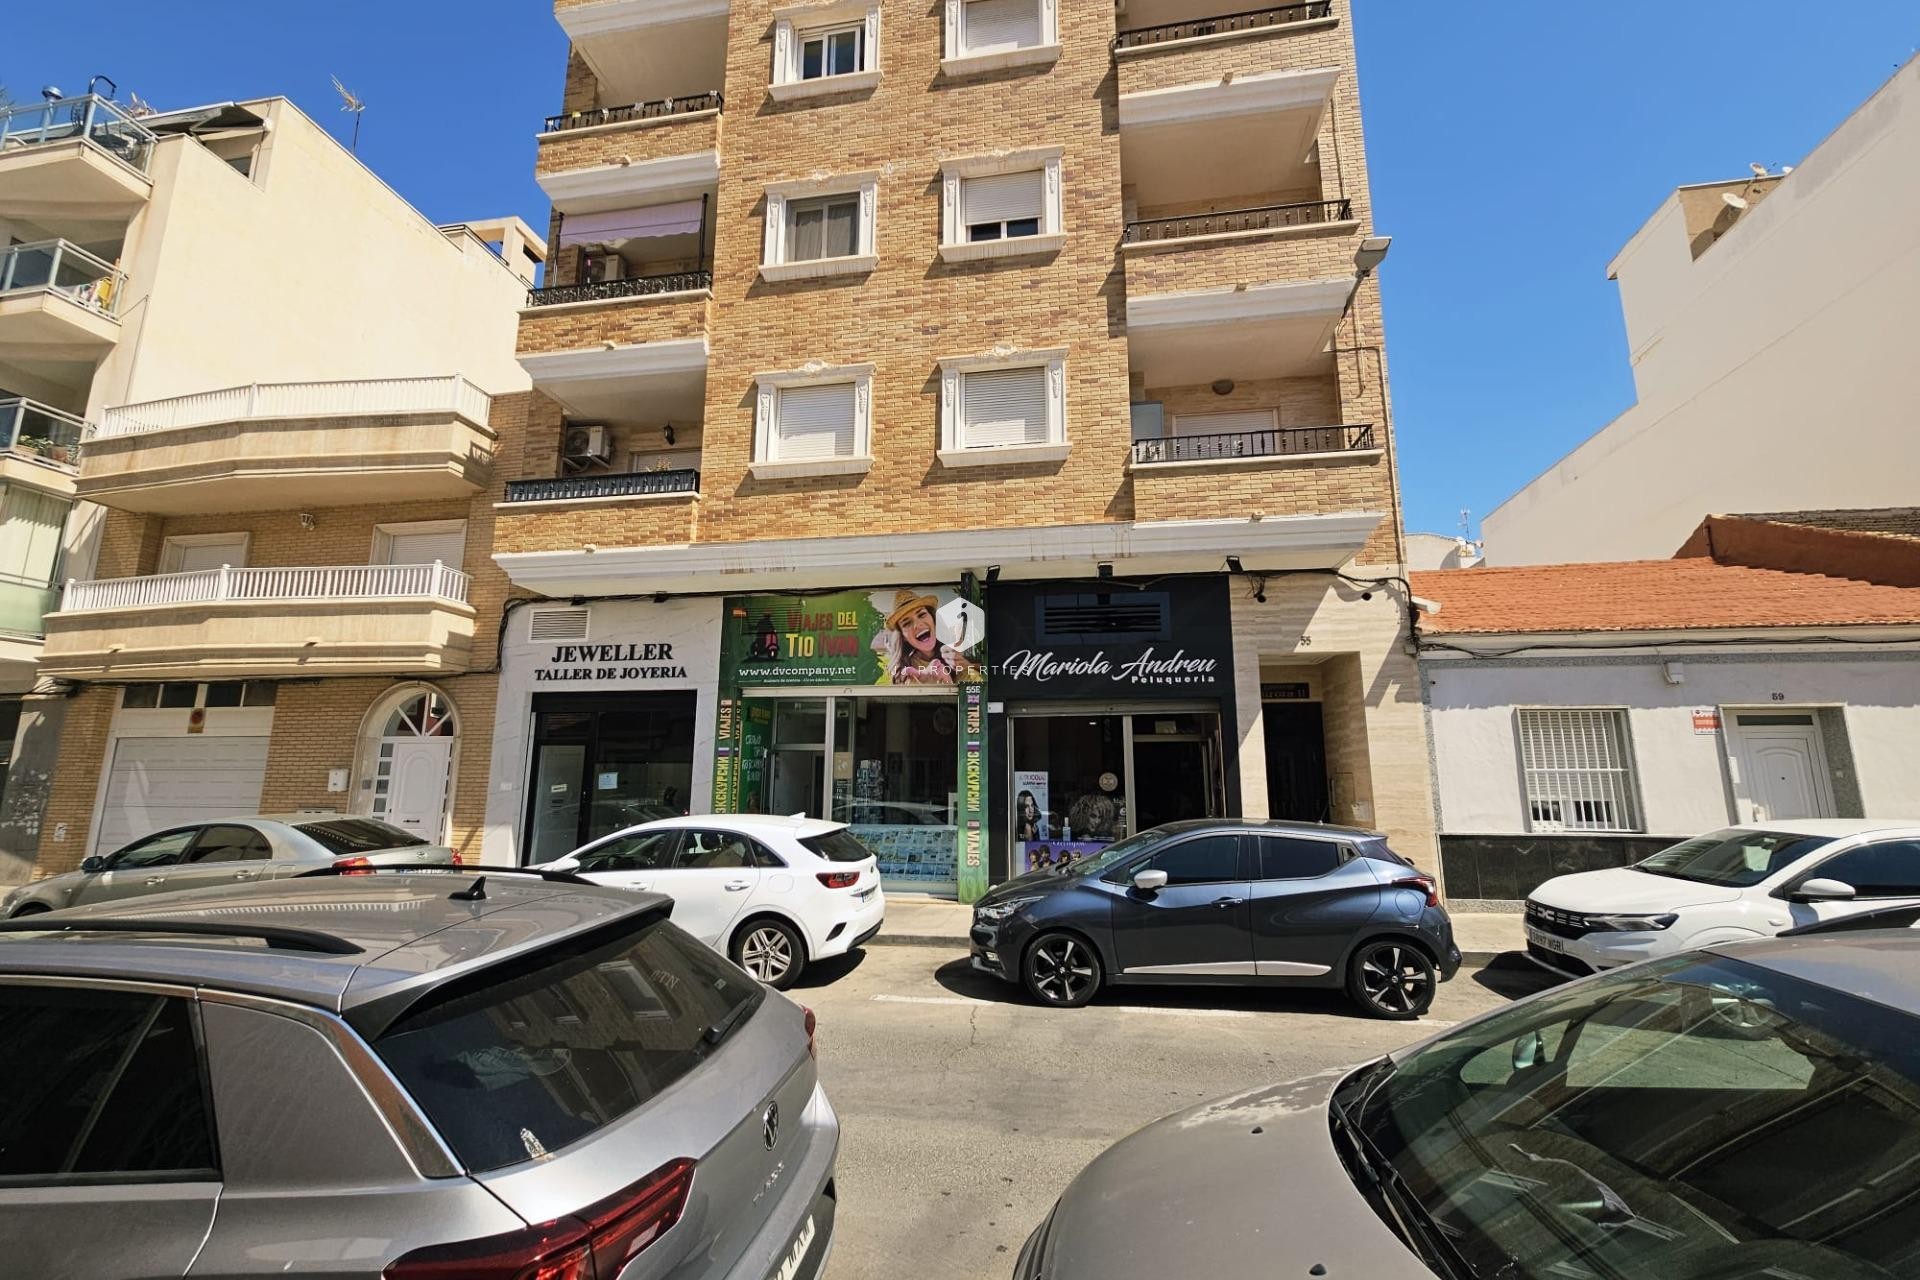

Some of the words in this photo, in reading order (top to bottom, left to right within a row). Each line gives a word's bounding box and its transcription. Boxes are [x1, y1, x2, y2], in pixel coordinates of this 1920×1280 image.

[838, 611, 859, 626] DEL
[786, 633, 814, 658] TIO
[1300, 635, 1312, 646] 55
[552, 643, 673, 663] JEWELLER
[534, 668, 593, 681] TALLER
[596, 667, 616, 680] DE
[620, 666, 687, 680] JOYERIA
[738, 666, 856, 677] www.dvcompany.net
[1002, 649, 1113, 682] Mariola
[1112, 647, 1218, 681] Andreu
[1771, 692, 1785, 701] 59
[718, 707, 732, 740] VIAJES
[967, 705, 980, 734] TRIPS
[967, 751, 980, 812] ЭКСКУРСИИ
[967, 830, 980, 866] VIAJES
